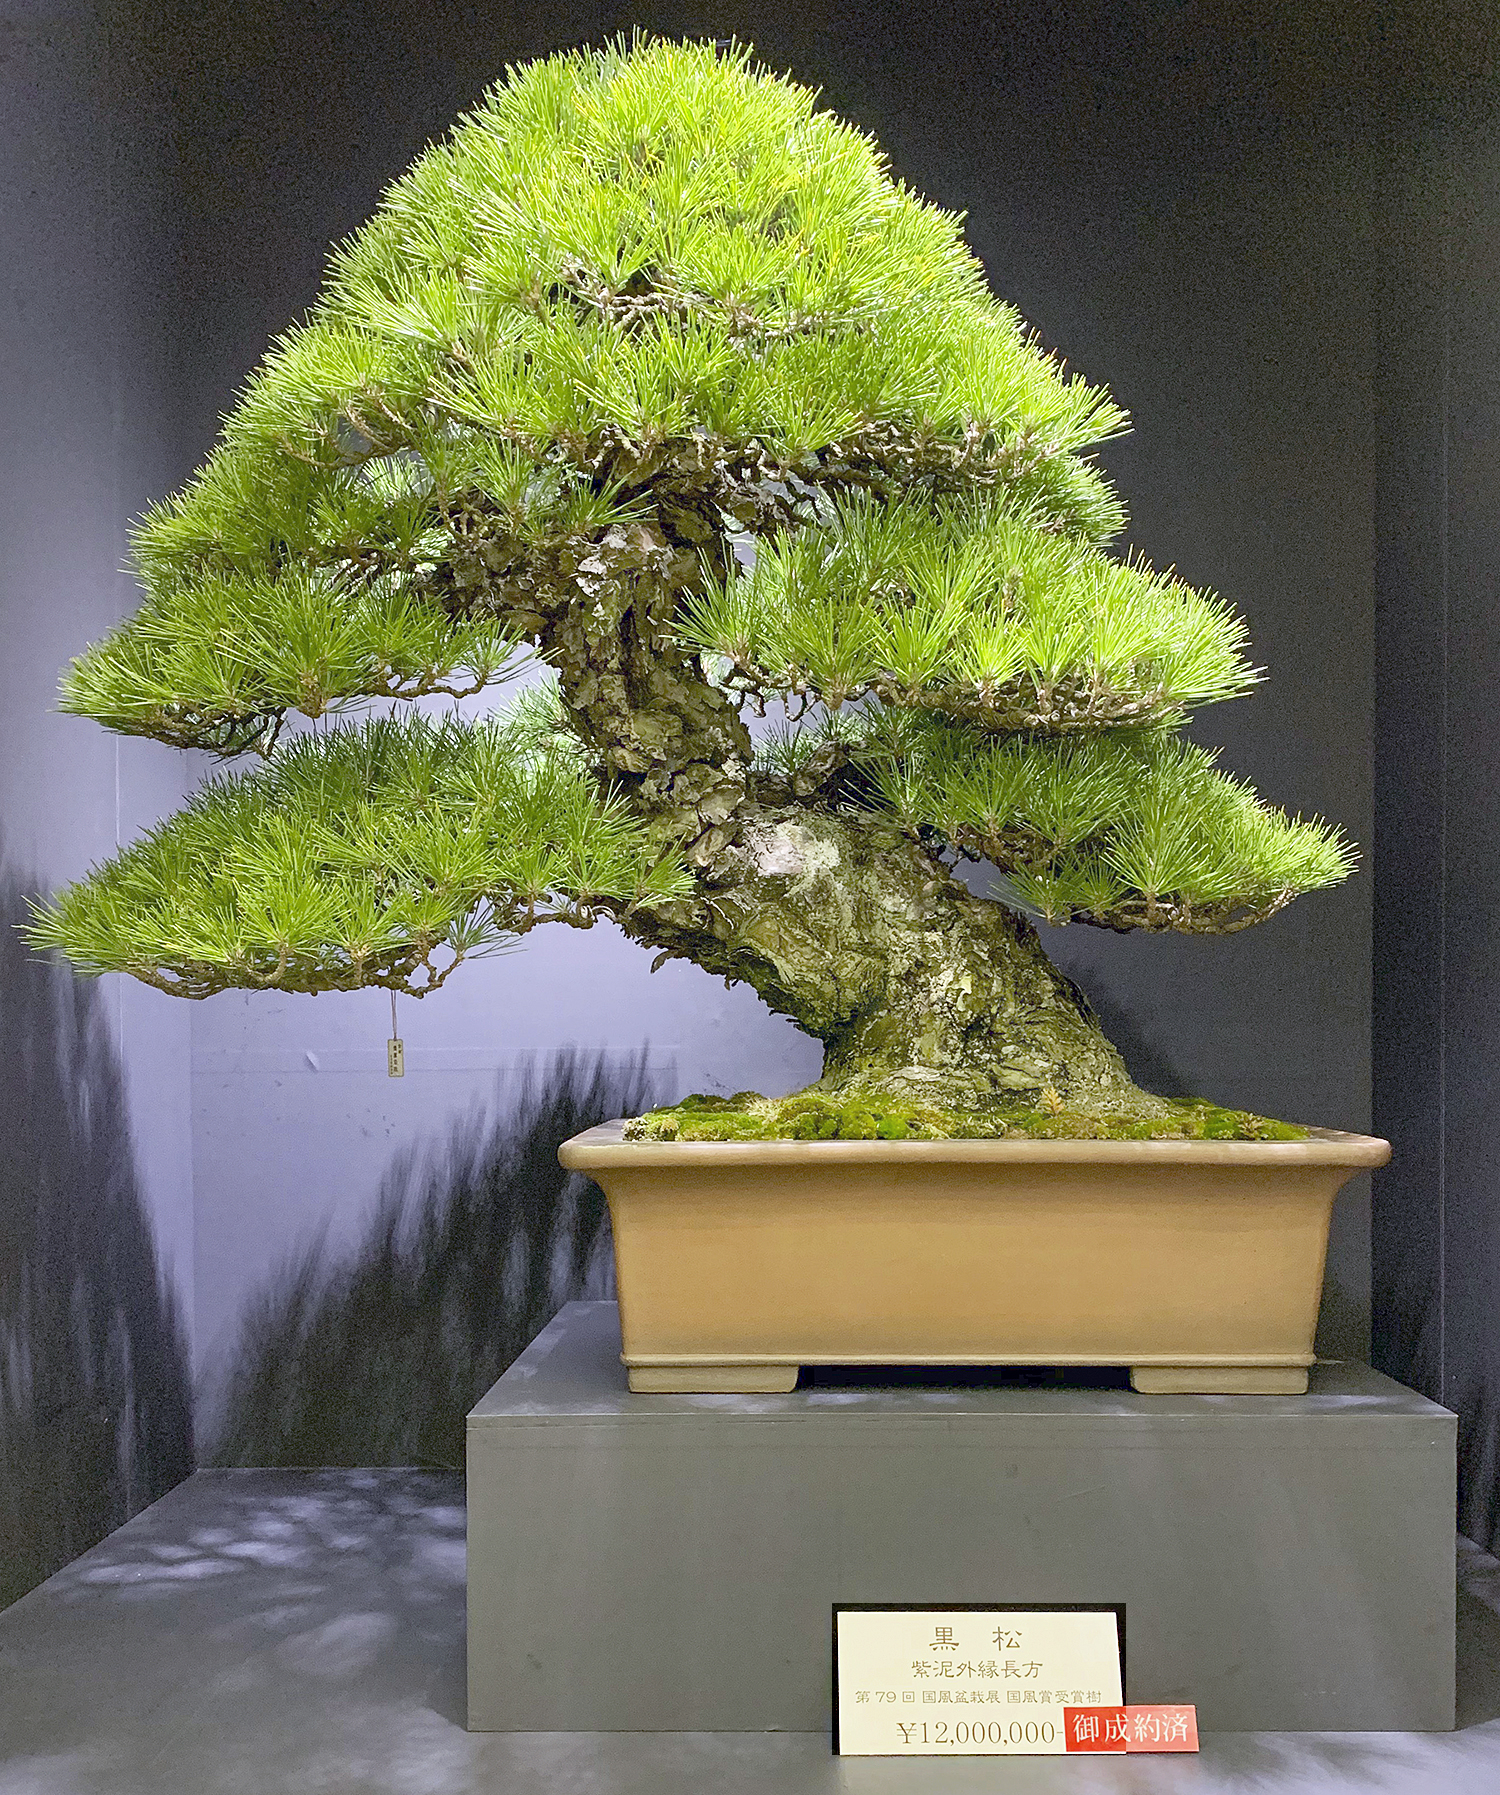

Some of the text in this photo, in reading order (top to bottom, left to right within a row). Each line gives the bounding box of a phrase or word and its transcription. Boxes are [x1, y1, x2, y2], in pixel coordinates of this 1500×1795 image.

[911, 1660, 1043, 1678] 紫泥外縁長方
[1073, 1713, 1188, 1743] 御成約済
